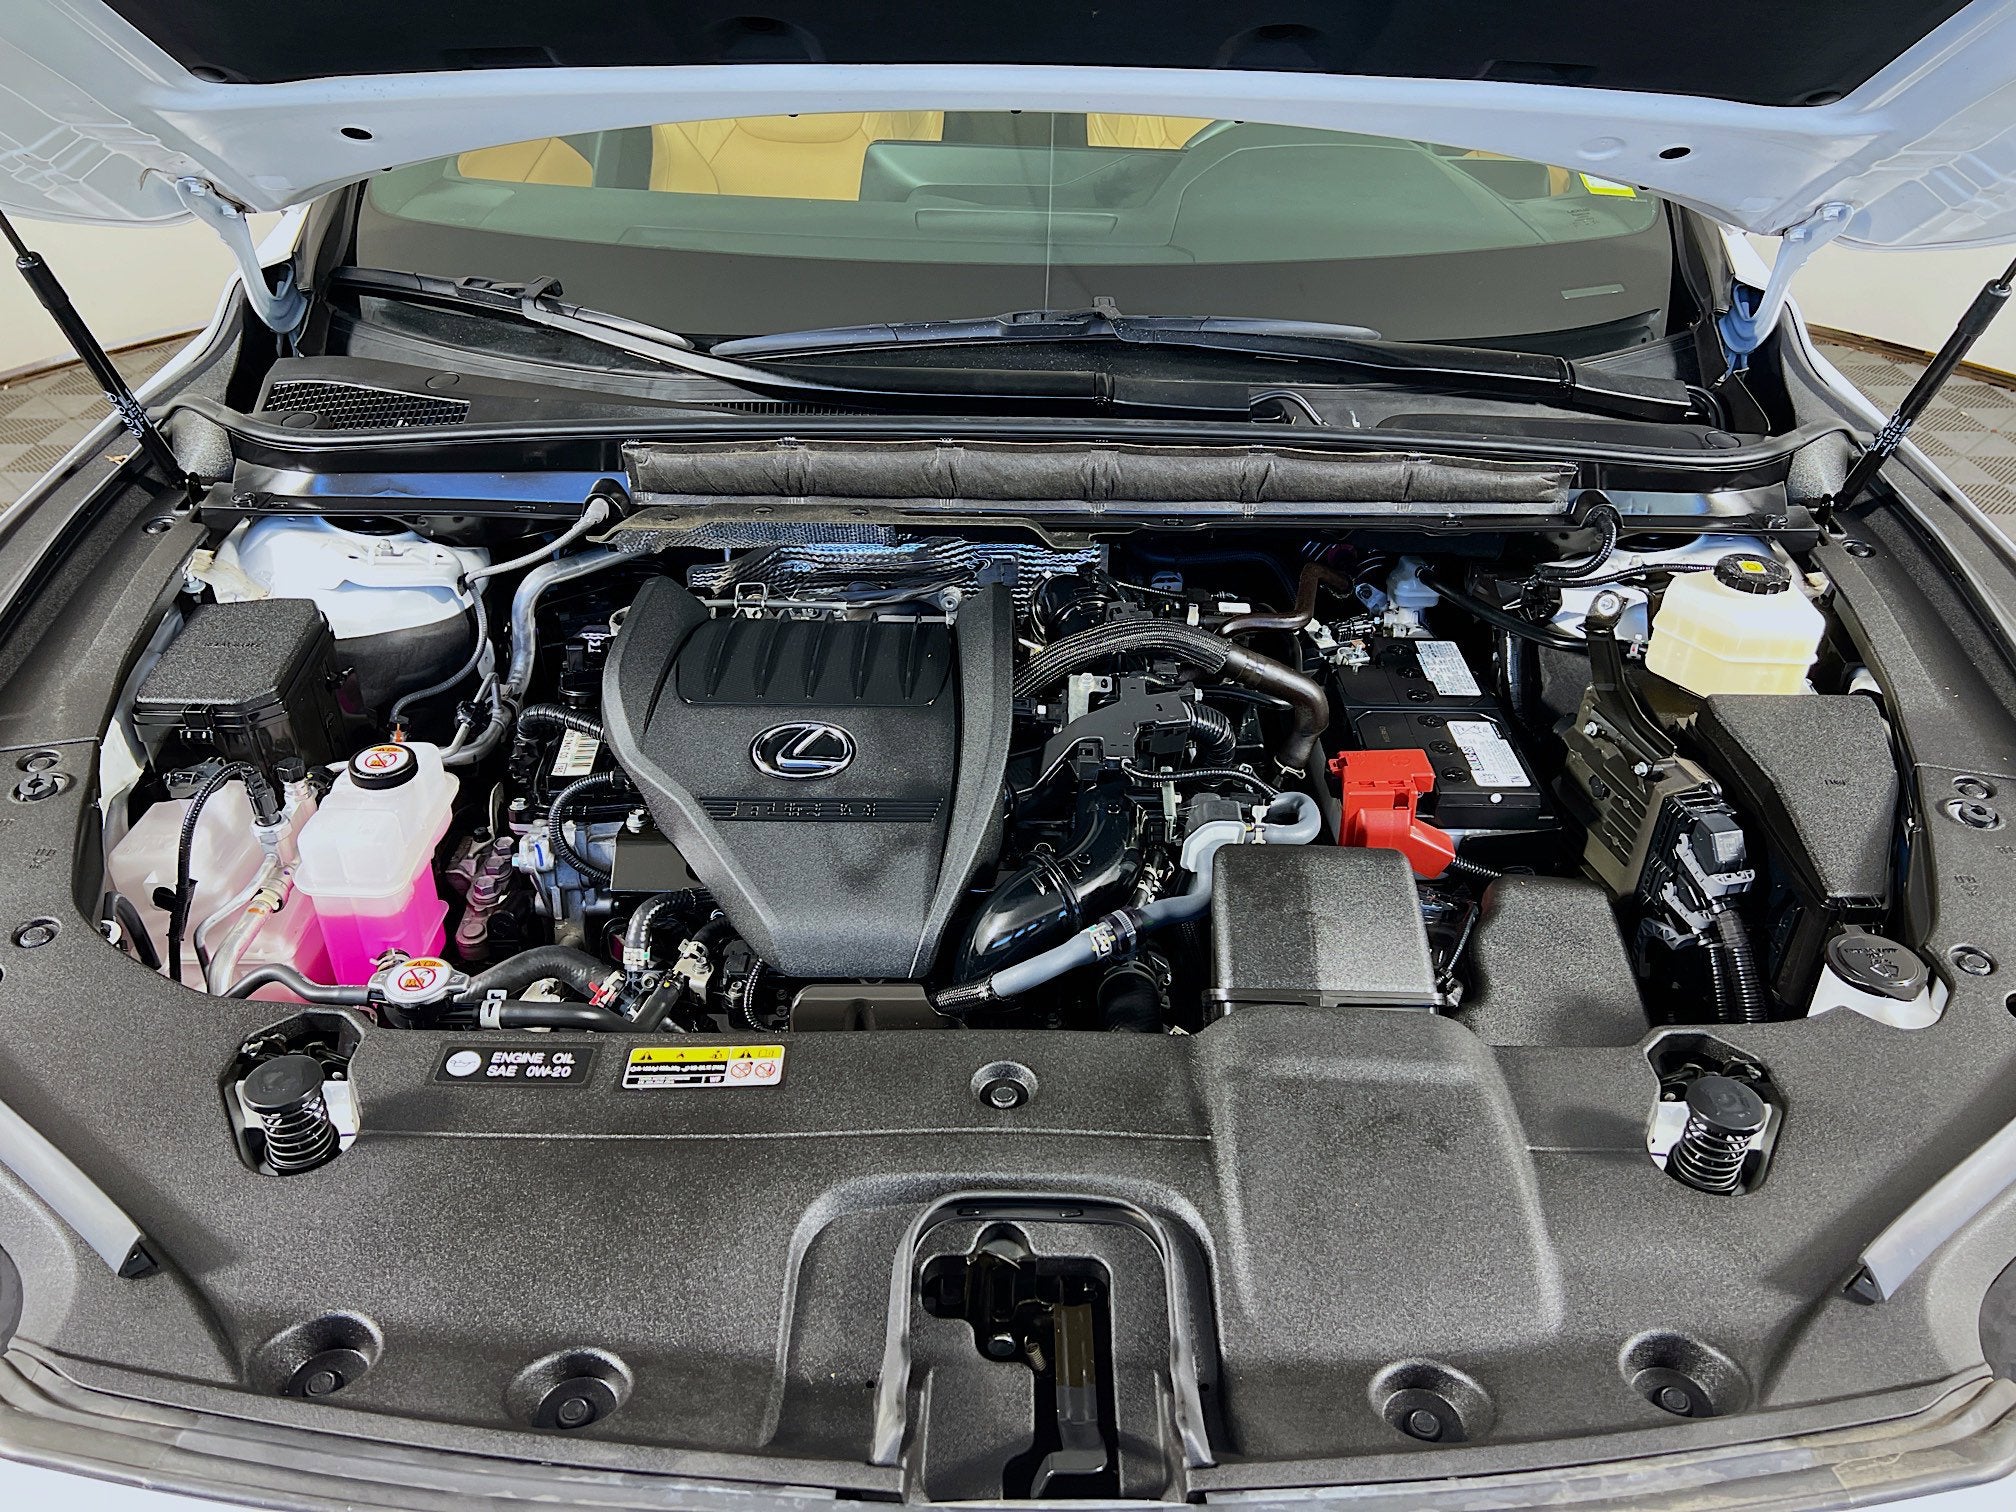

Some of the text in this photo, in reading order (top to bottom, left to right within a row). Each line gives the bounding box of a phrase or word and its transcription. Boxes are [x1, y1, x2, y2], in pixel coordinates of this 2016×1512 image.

[490, 1051, 575, 1064] ENGINE OIL
[486, 1065, 572, 1078] SAE 0W-20
